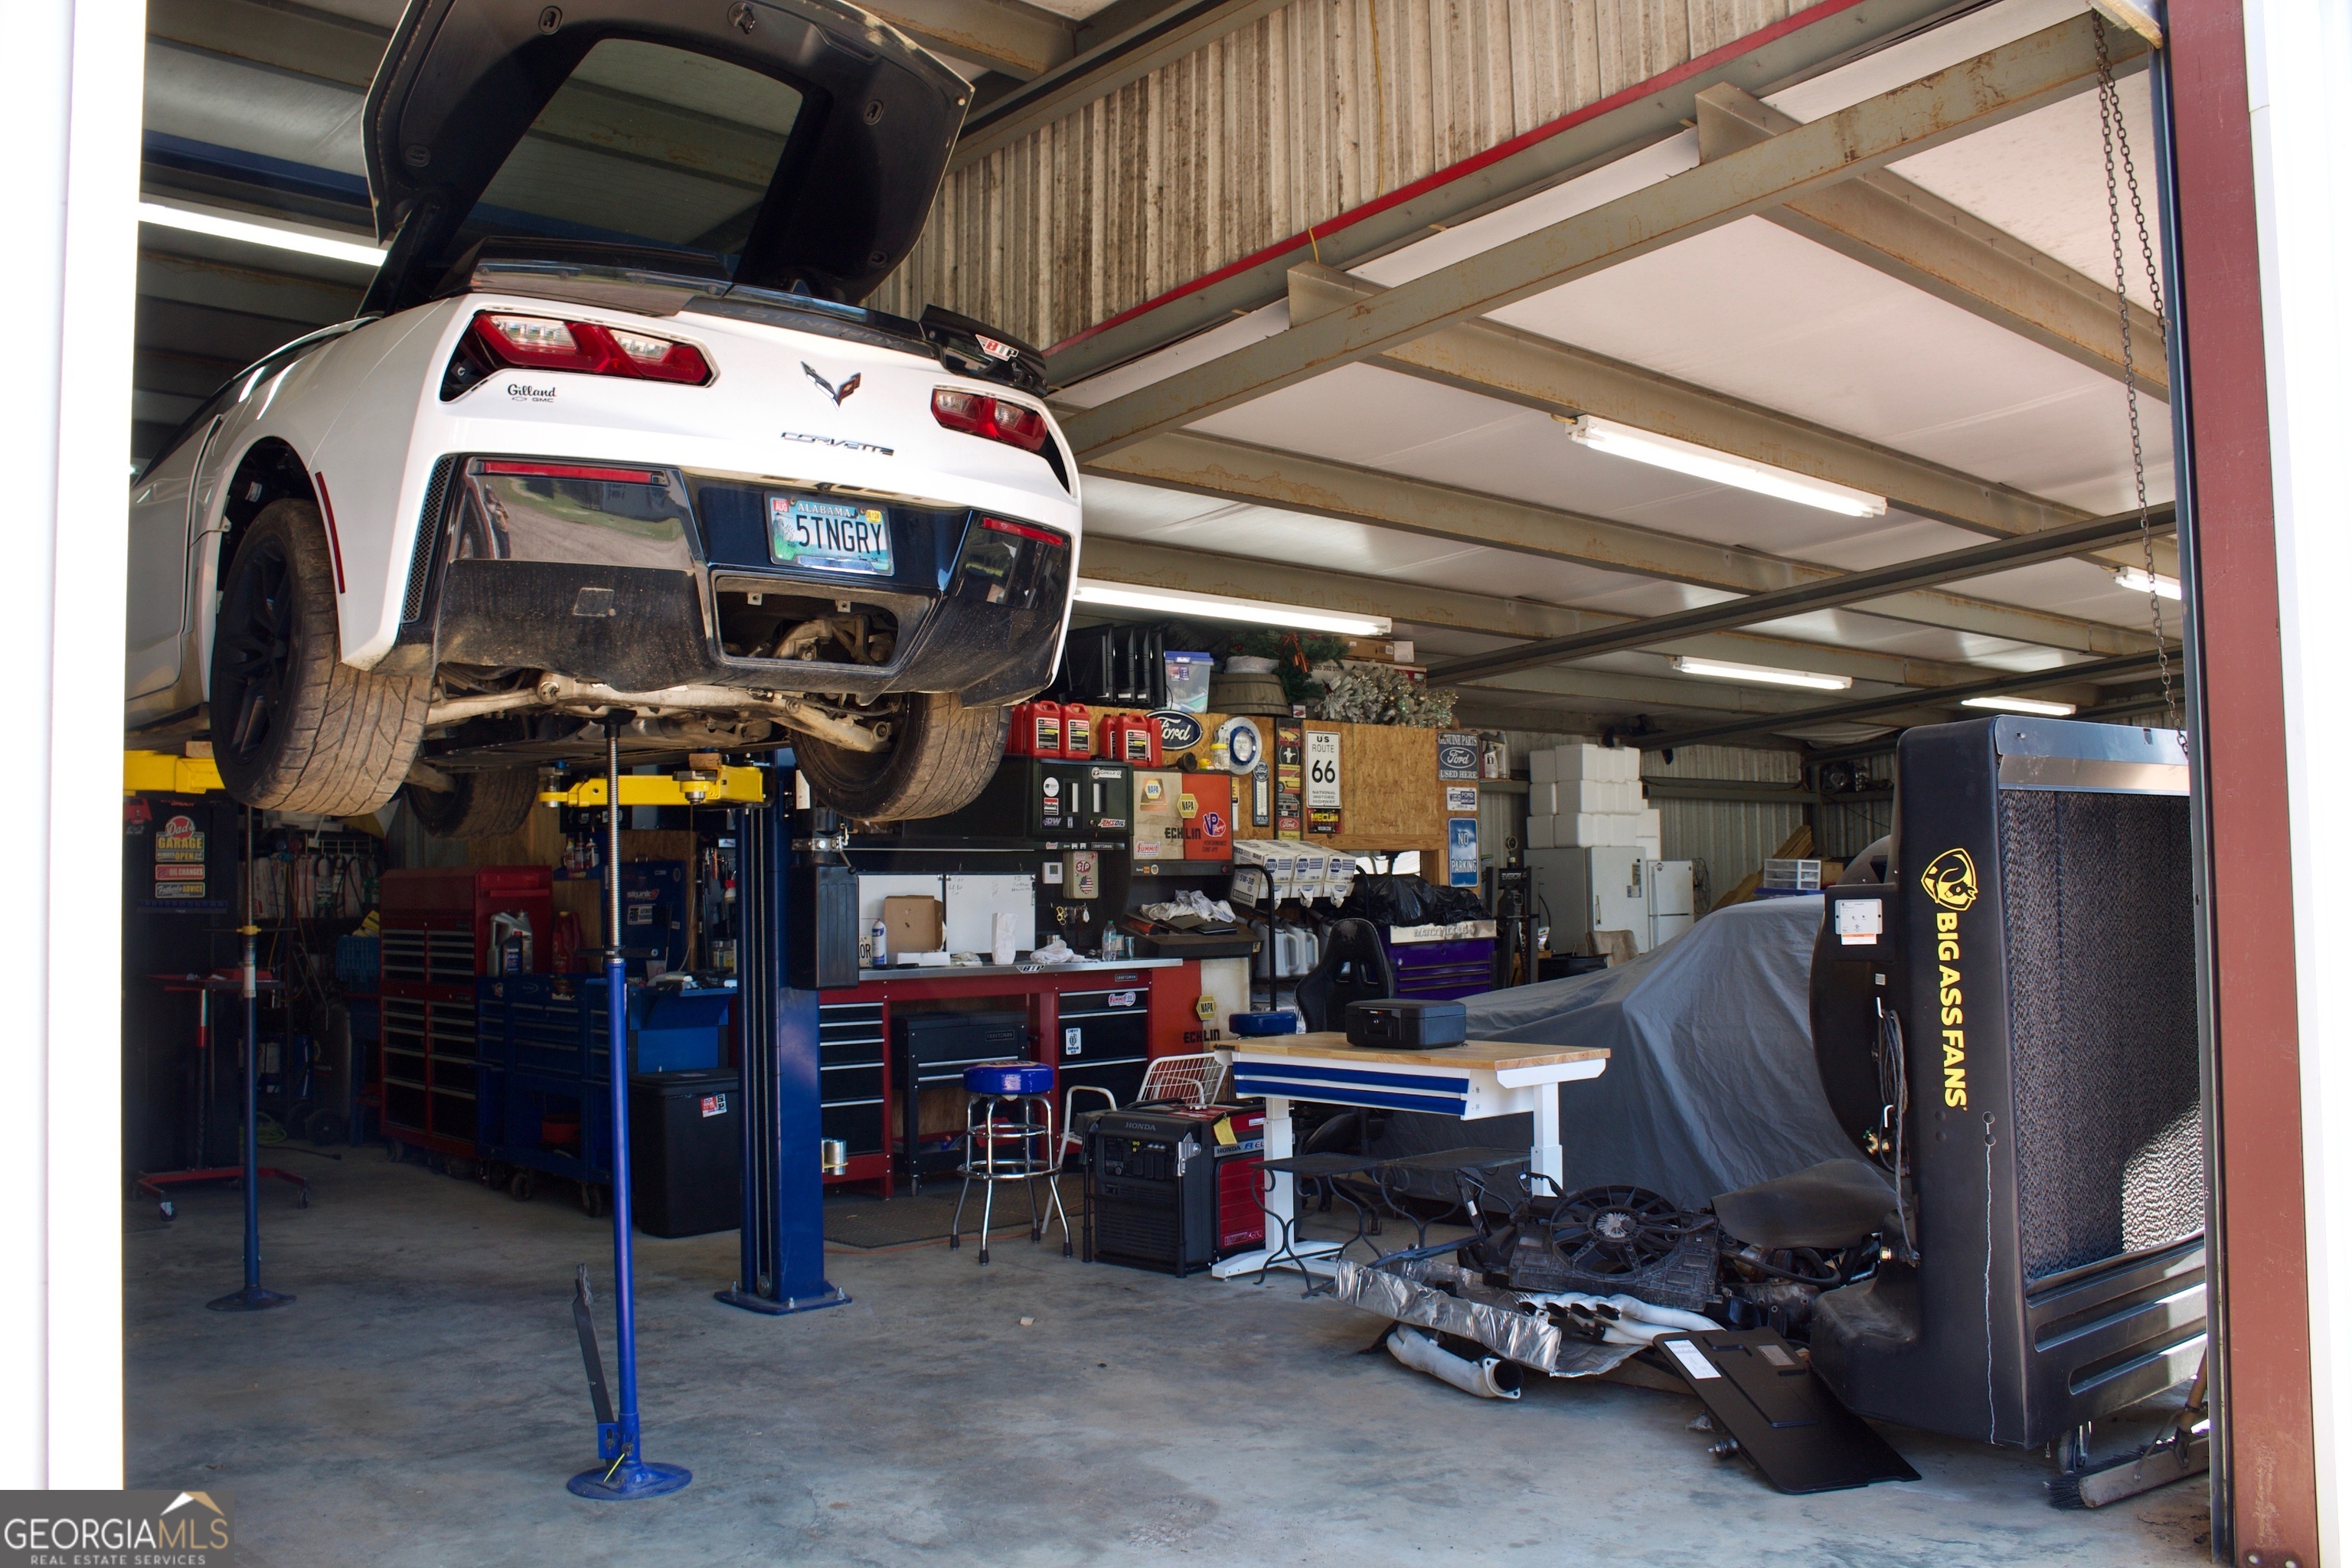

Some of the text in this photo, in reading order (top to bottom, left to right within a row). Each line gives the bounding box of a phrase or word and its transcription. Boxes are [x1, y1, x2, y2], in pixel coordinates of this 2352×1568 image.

[508, 384, 557, 397] Gilland
[781, 432, 894, 456] CORVETTE
[775, 501, 788, 511] AUG
[797, 502, 851, 518] ALABAMA
[796, 514, 881, 555] 5TNGRY
[1158, 717, 1191, 741] Ford
[1439, 734, 1478, 746] GENUINE PARTS
[1312, 744, 1334, 753] ROUTE
[1447, 750, 1470, 764] Ford
[1312, 760, 1335, 783] 66
[1440, 769, 1459, 778] USED
[1147, 785, 1159, 794] NAPA
[1181, 801, 1194, 811] NAPA
[1311, 812, 1338, 822] MECUM
[165, 821, 195, 837] Dad's
[1164, 827, 1201, 840] ECHLIN
[158, 837, 202, 849] GARAGE
[1458, 831, 1469, 846] NO
[1138, 842, 1159, 852] SUMMIT
[175, 851, 194, 861] OPEN
[169, 867, 178, 877] OIL
[178, 867, 204, 876] CHANGES
[1076, 861, 1089, 871] STP
[1451, 858, 1477, 874] PARKING
[1239, 874, 1255, 885] 5W-30
[182, 884, 203, 893] ADVICE
[859, 944, 871, 959] OR
[1200, 1002, 1214, 1013] NAPA
[1936, 912, 1967, 1108] BIG ASS FANS
[987, 1031, 1013, 1040] CRAFTSMAN
[1183, 1029, 1220, 1044] ECHLIN
[1125, 1122, 1157, 1131] HONDA
